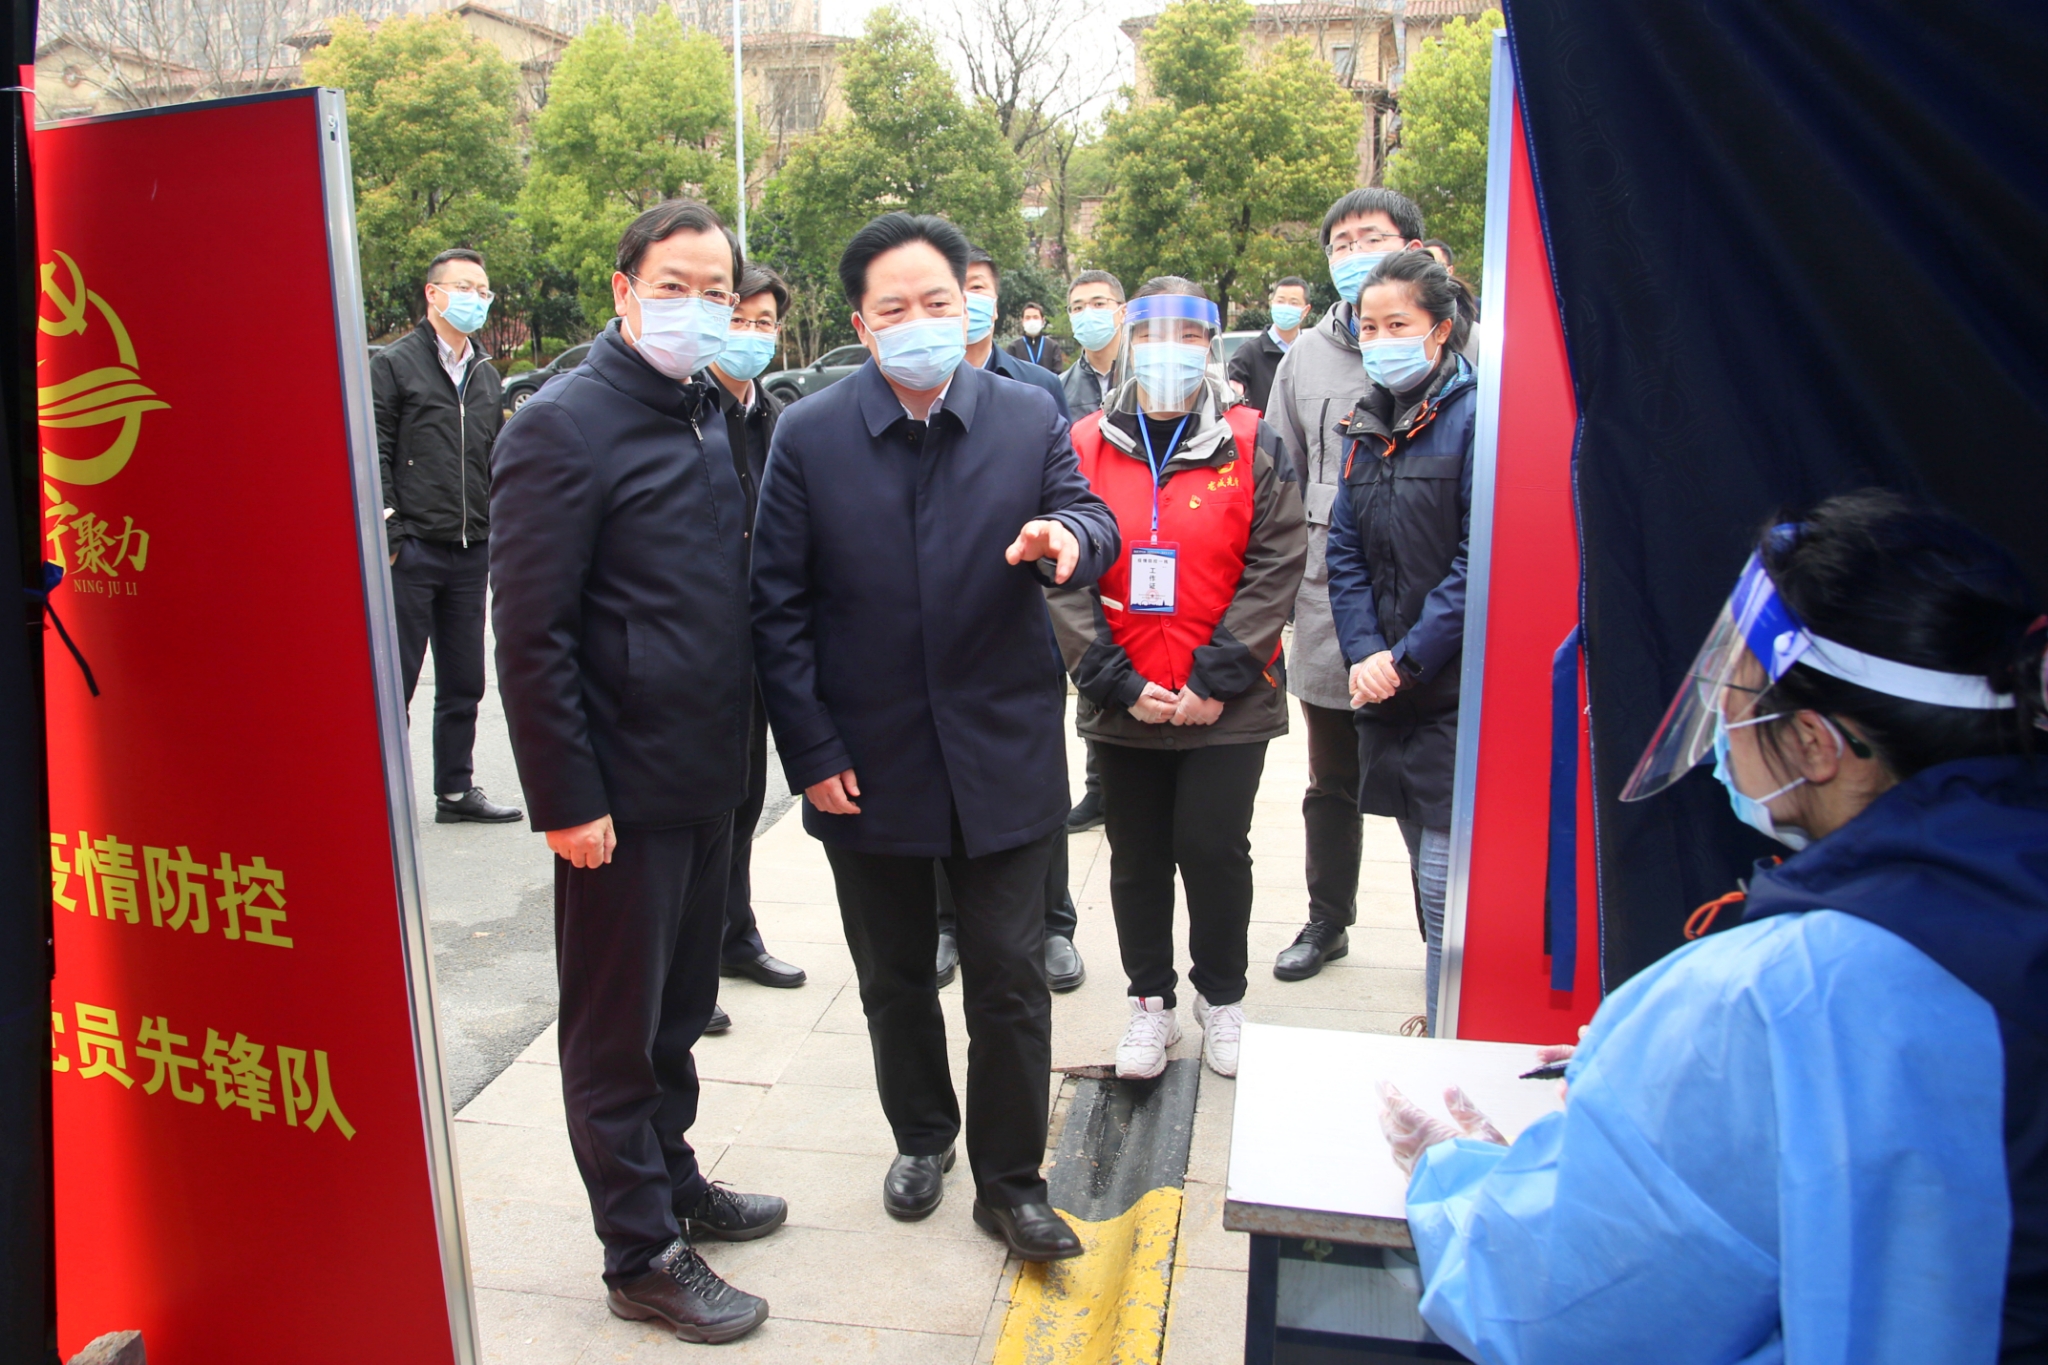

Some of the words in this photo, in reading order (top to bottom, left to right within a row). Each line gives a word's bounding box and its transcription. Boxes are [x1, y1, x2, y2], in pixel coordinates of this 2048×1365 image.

[73, 579, 104, 594] NING
[108, 581, 120, 598] JU
[126, 582, 138, 596] LI
[51, 1000, 356, 1141] 员先锋队
[662, 1241, 680, 1262] ecco
